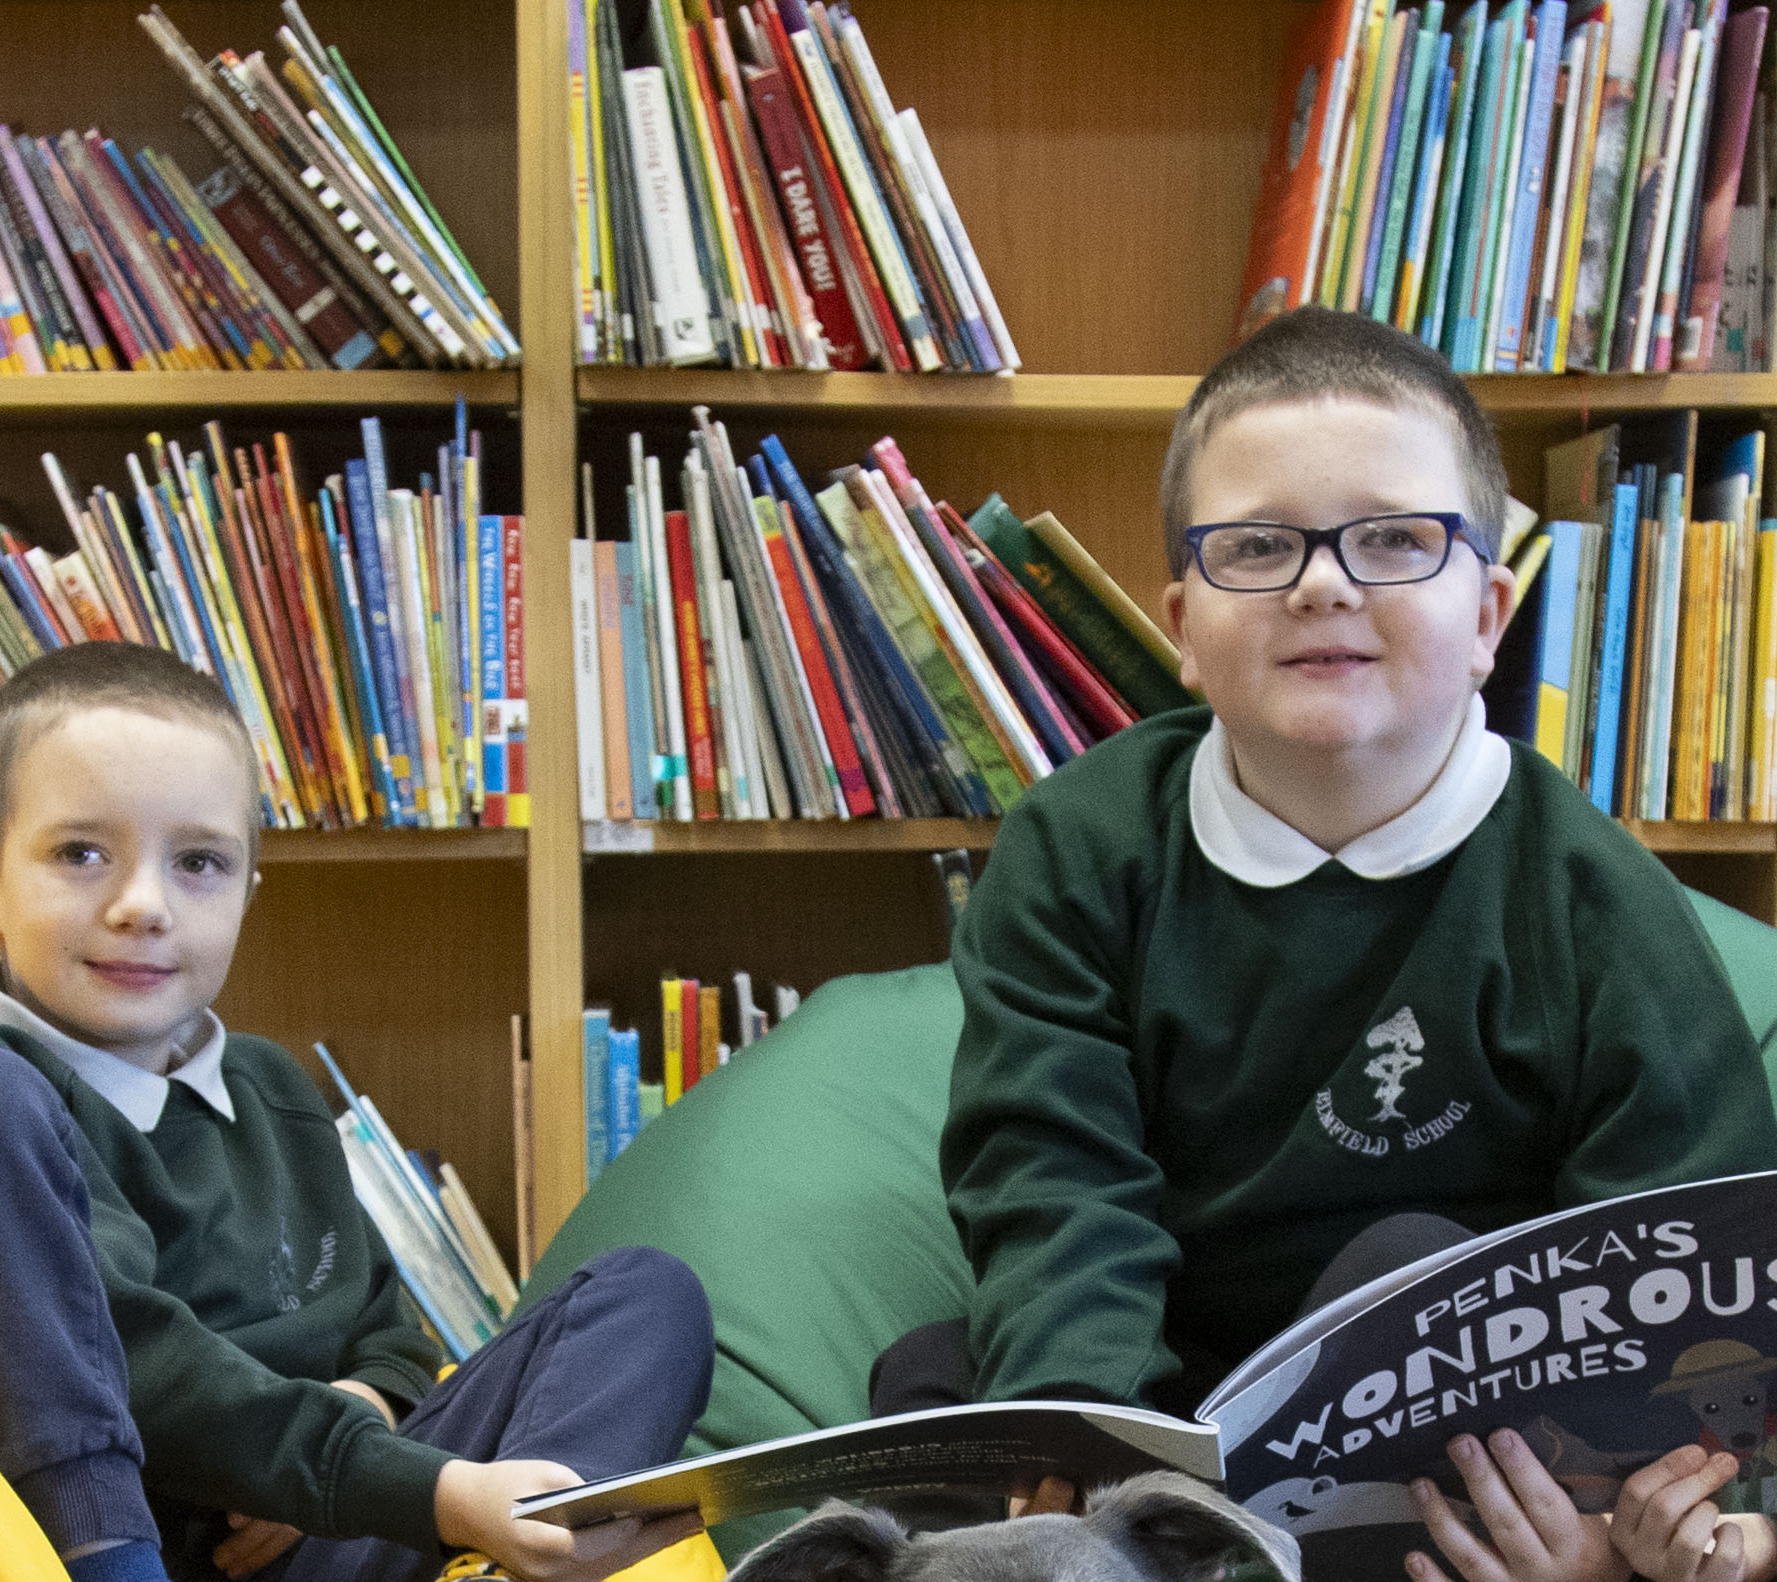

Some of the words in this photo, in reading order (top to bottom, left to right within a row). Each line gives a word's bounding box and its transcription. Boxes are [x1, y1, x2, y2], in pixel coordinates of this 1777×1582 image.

[784, 184, 820, 238] DARE
[1403, 1100, 1472, 1151] SCHOOL
[1414, 1220, 1699, 1338] PENKA'S
[1312, 1338, 1648, 1468] ADVENTURES
